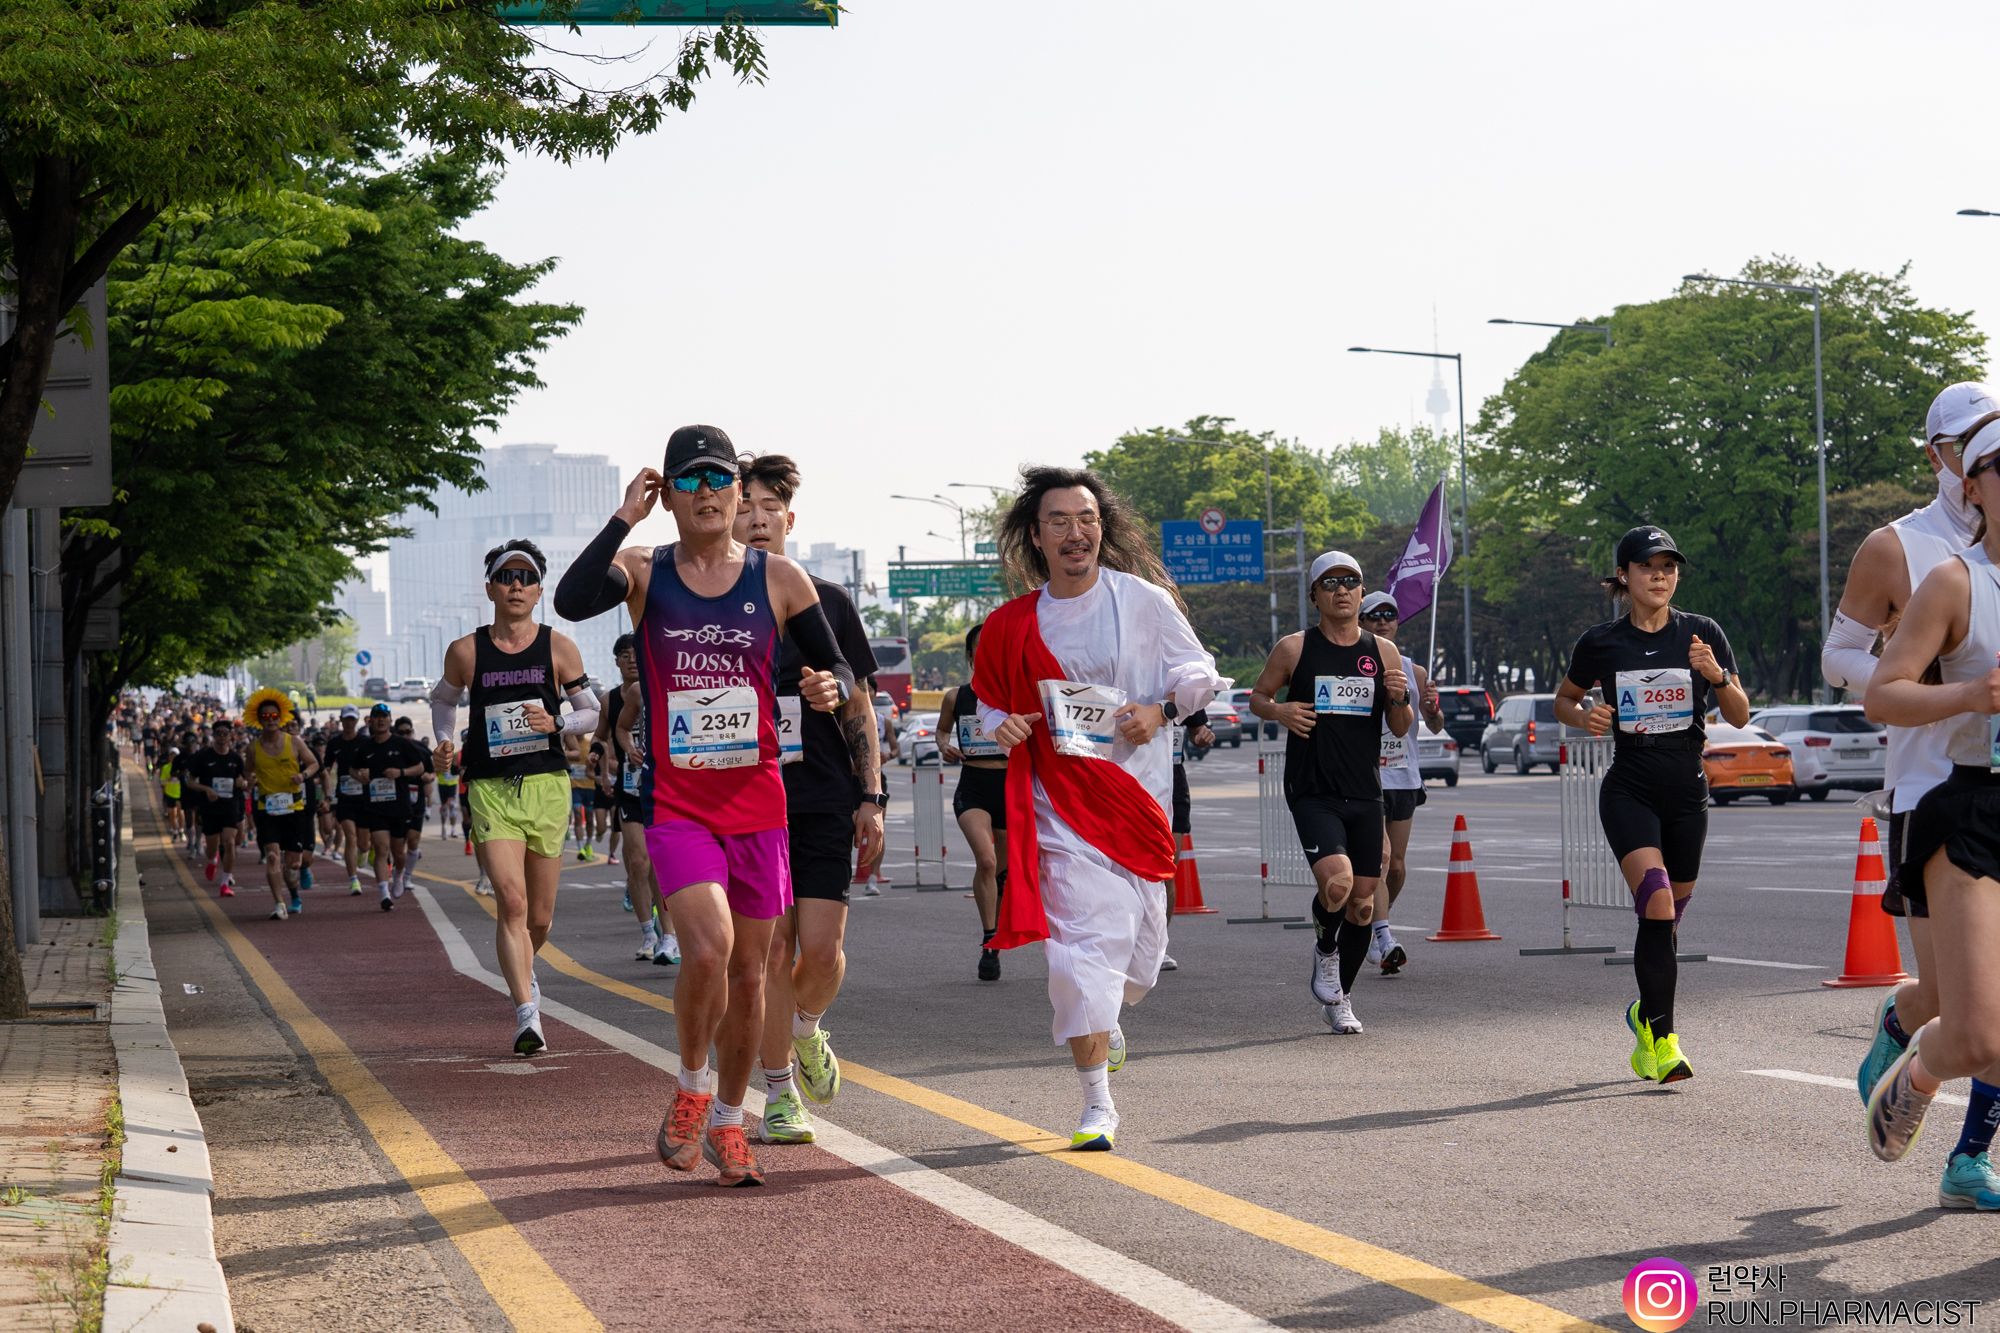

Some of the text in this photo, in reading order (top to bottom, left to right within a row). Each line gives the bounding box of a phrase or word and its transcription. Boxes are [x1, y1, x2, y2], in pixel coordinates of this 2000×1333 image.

[675, 651, 745, 673] DOSSA
[482, 668, 546, 688] OPENCARE
[671, 674, 750, 689] TRIATHLON
[1318, 685, 1370, 698] A 2093
[1620, 688, 1686, 707] A 2638
[1064, 704, 1106, 723] 1727
[489, 717, 531, 735] A 120
[671, 712, 751, 736] A 2347
[779, 719, 792, 733] 2
[961, 727, 970, 738] A
[706, 756, 742, 767] 조선일보
[625, 772, 633, 782] B
